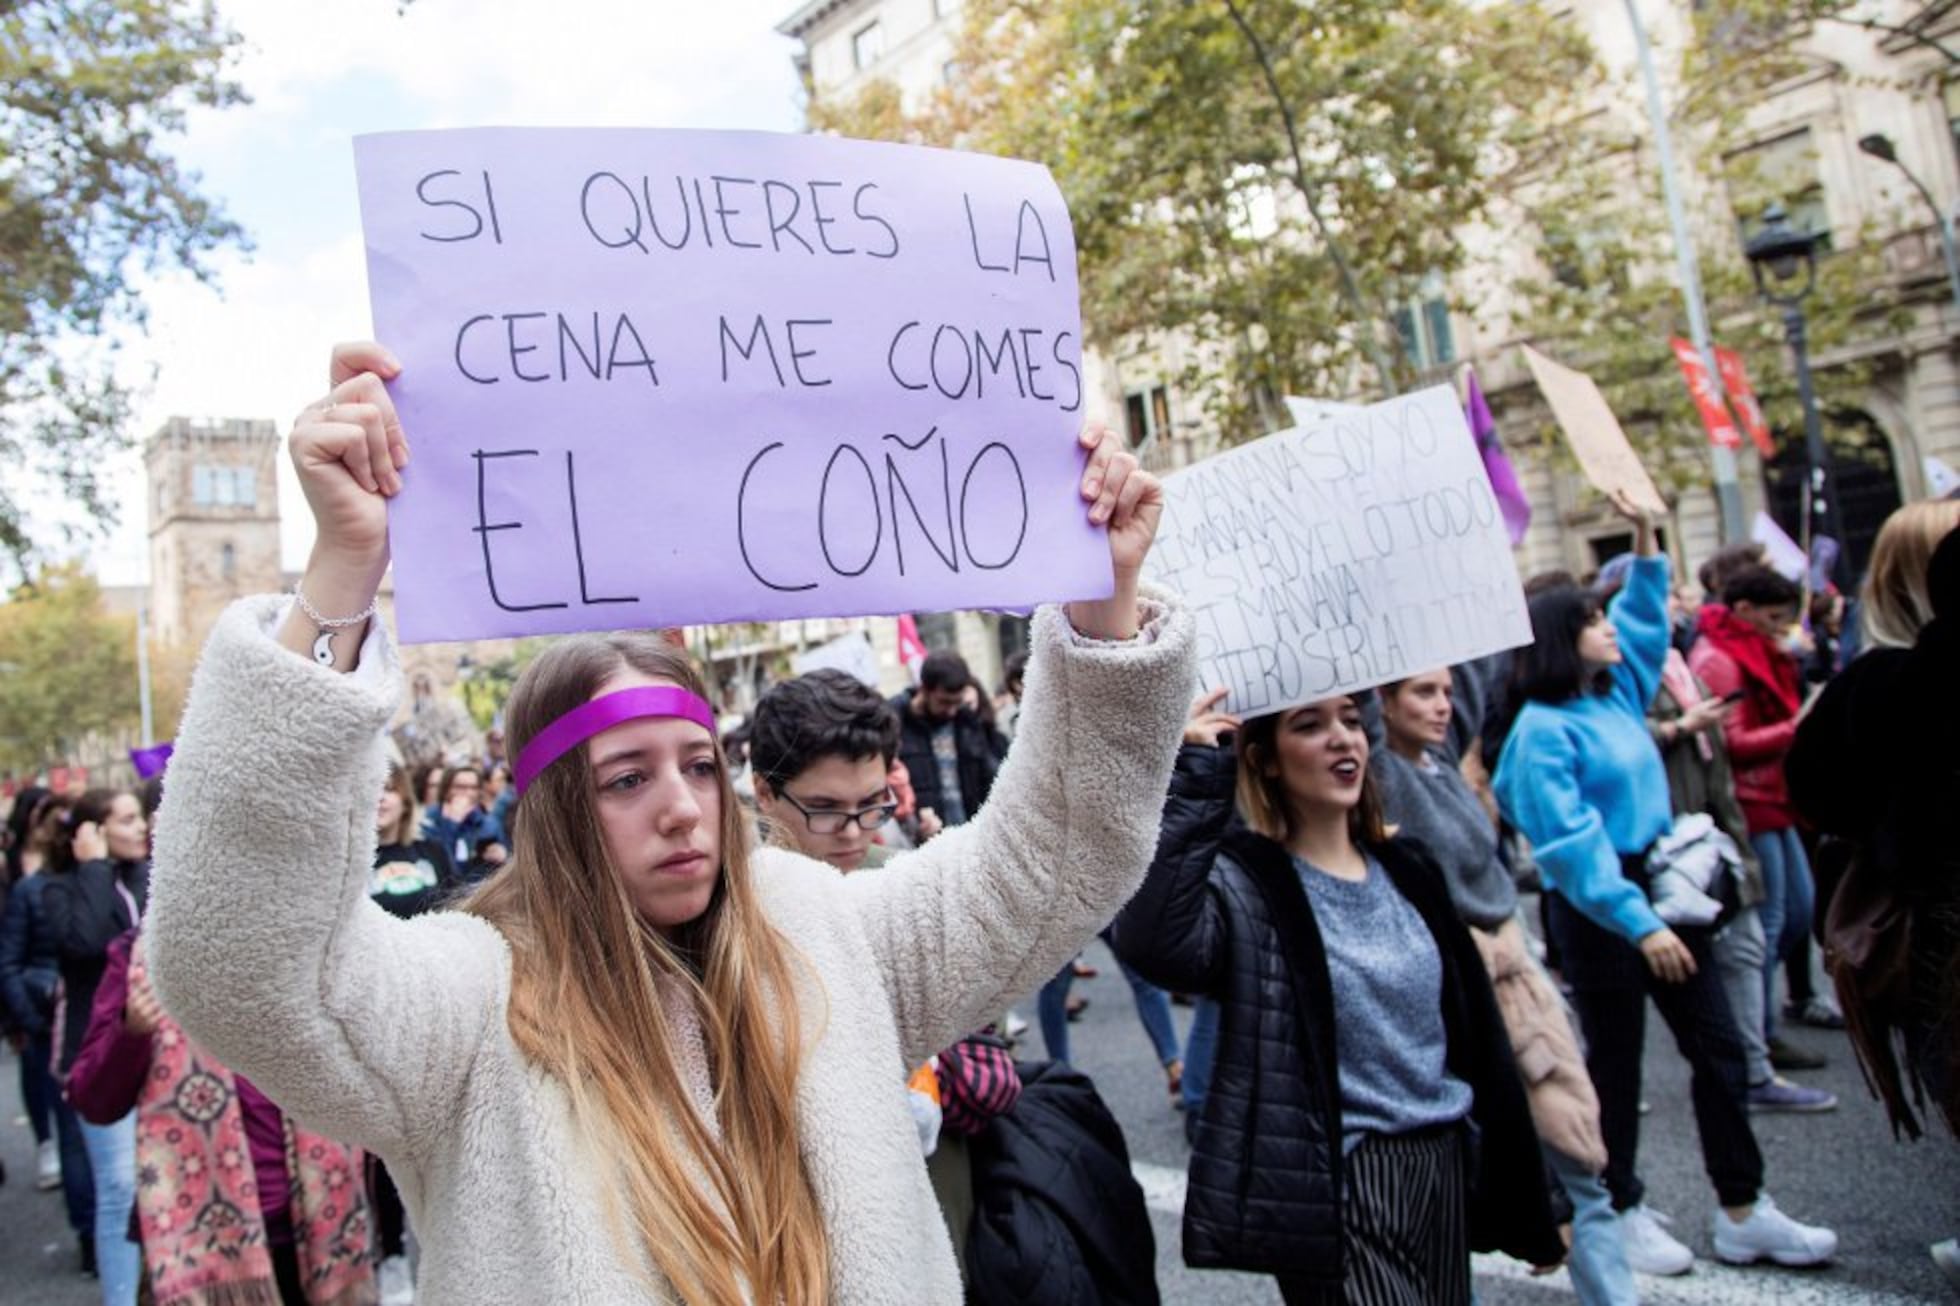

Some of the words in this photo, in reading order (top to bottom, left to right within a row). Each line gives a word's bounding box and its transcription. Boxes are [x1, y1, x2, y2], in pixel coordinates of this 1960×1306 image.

[416, 170, 503, 245] SI
[581, 170, 899, 259] QUIERES
[963, 191, 1056, 282] LA
[455, 311, 659, 387] CENA
[719, 314, 833, 388] ME
[887, 320, 1083, 412] COMES
[1300, 412, 1376, 483] SOY
[1379, 401, 1438, 476] YO
[470, 448, 640, 612] EL
[736, 426, 1029, 592] COÑO
[1383, 476, 1496, 548] TODO
